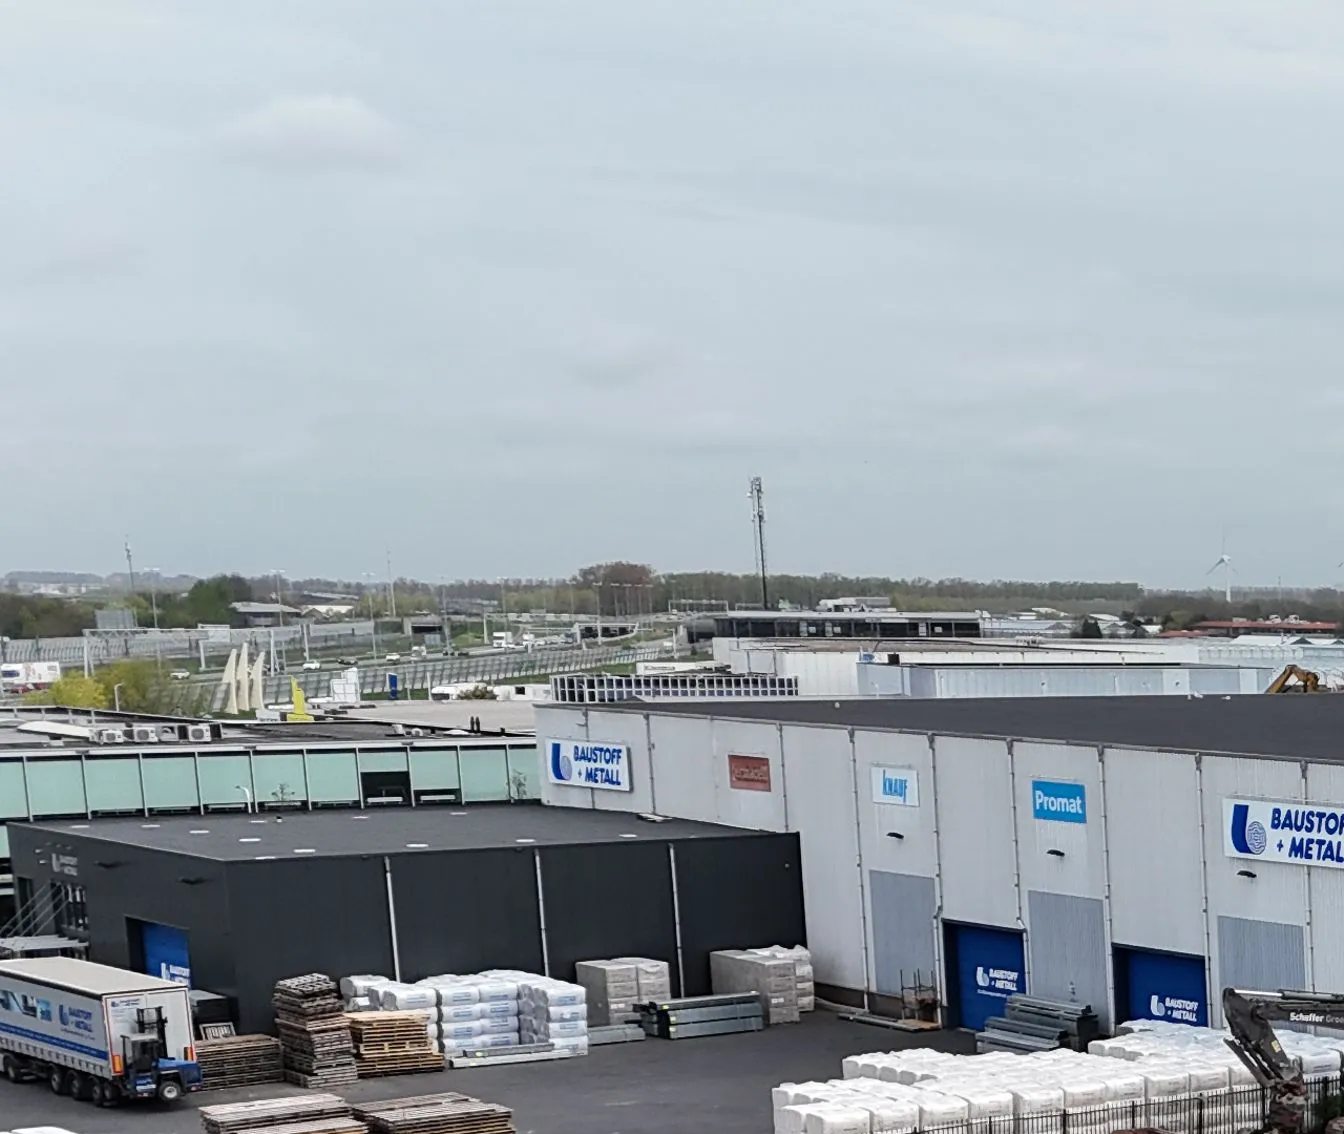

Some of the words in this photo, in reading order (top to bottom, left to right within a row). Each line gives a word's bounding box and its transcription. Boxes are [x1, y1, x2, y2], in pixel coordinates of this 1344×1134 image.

[574, 745, 622, 764] BAUSTOFF
[585, 767, 621, 785] METALL
[1035, 790, 1082, 814] Promat
